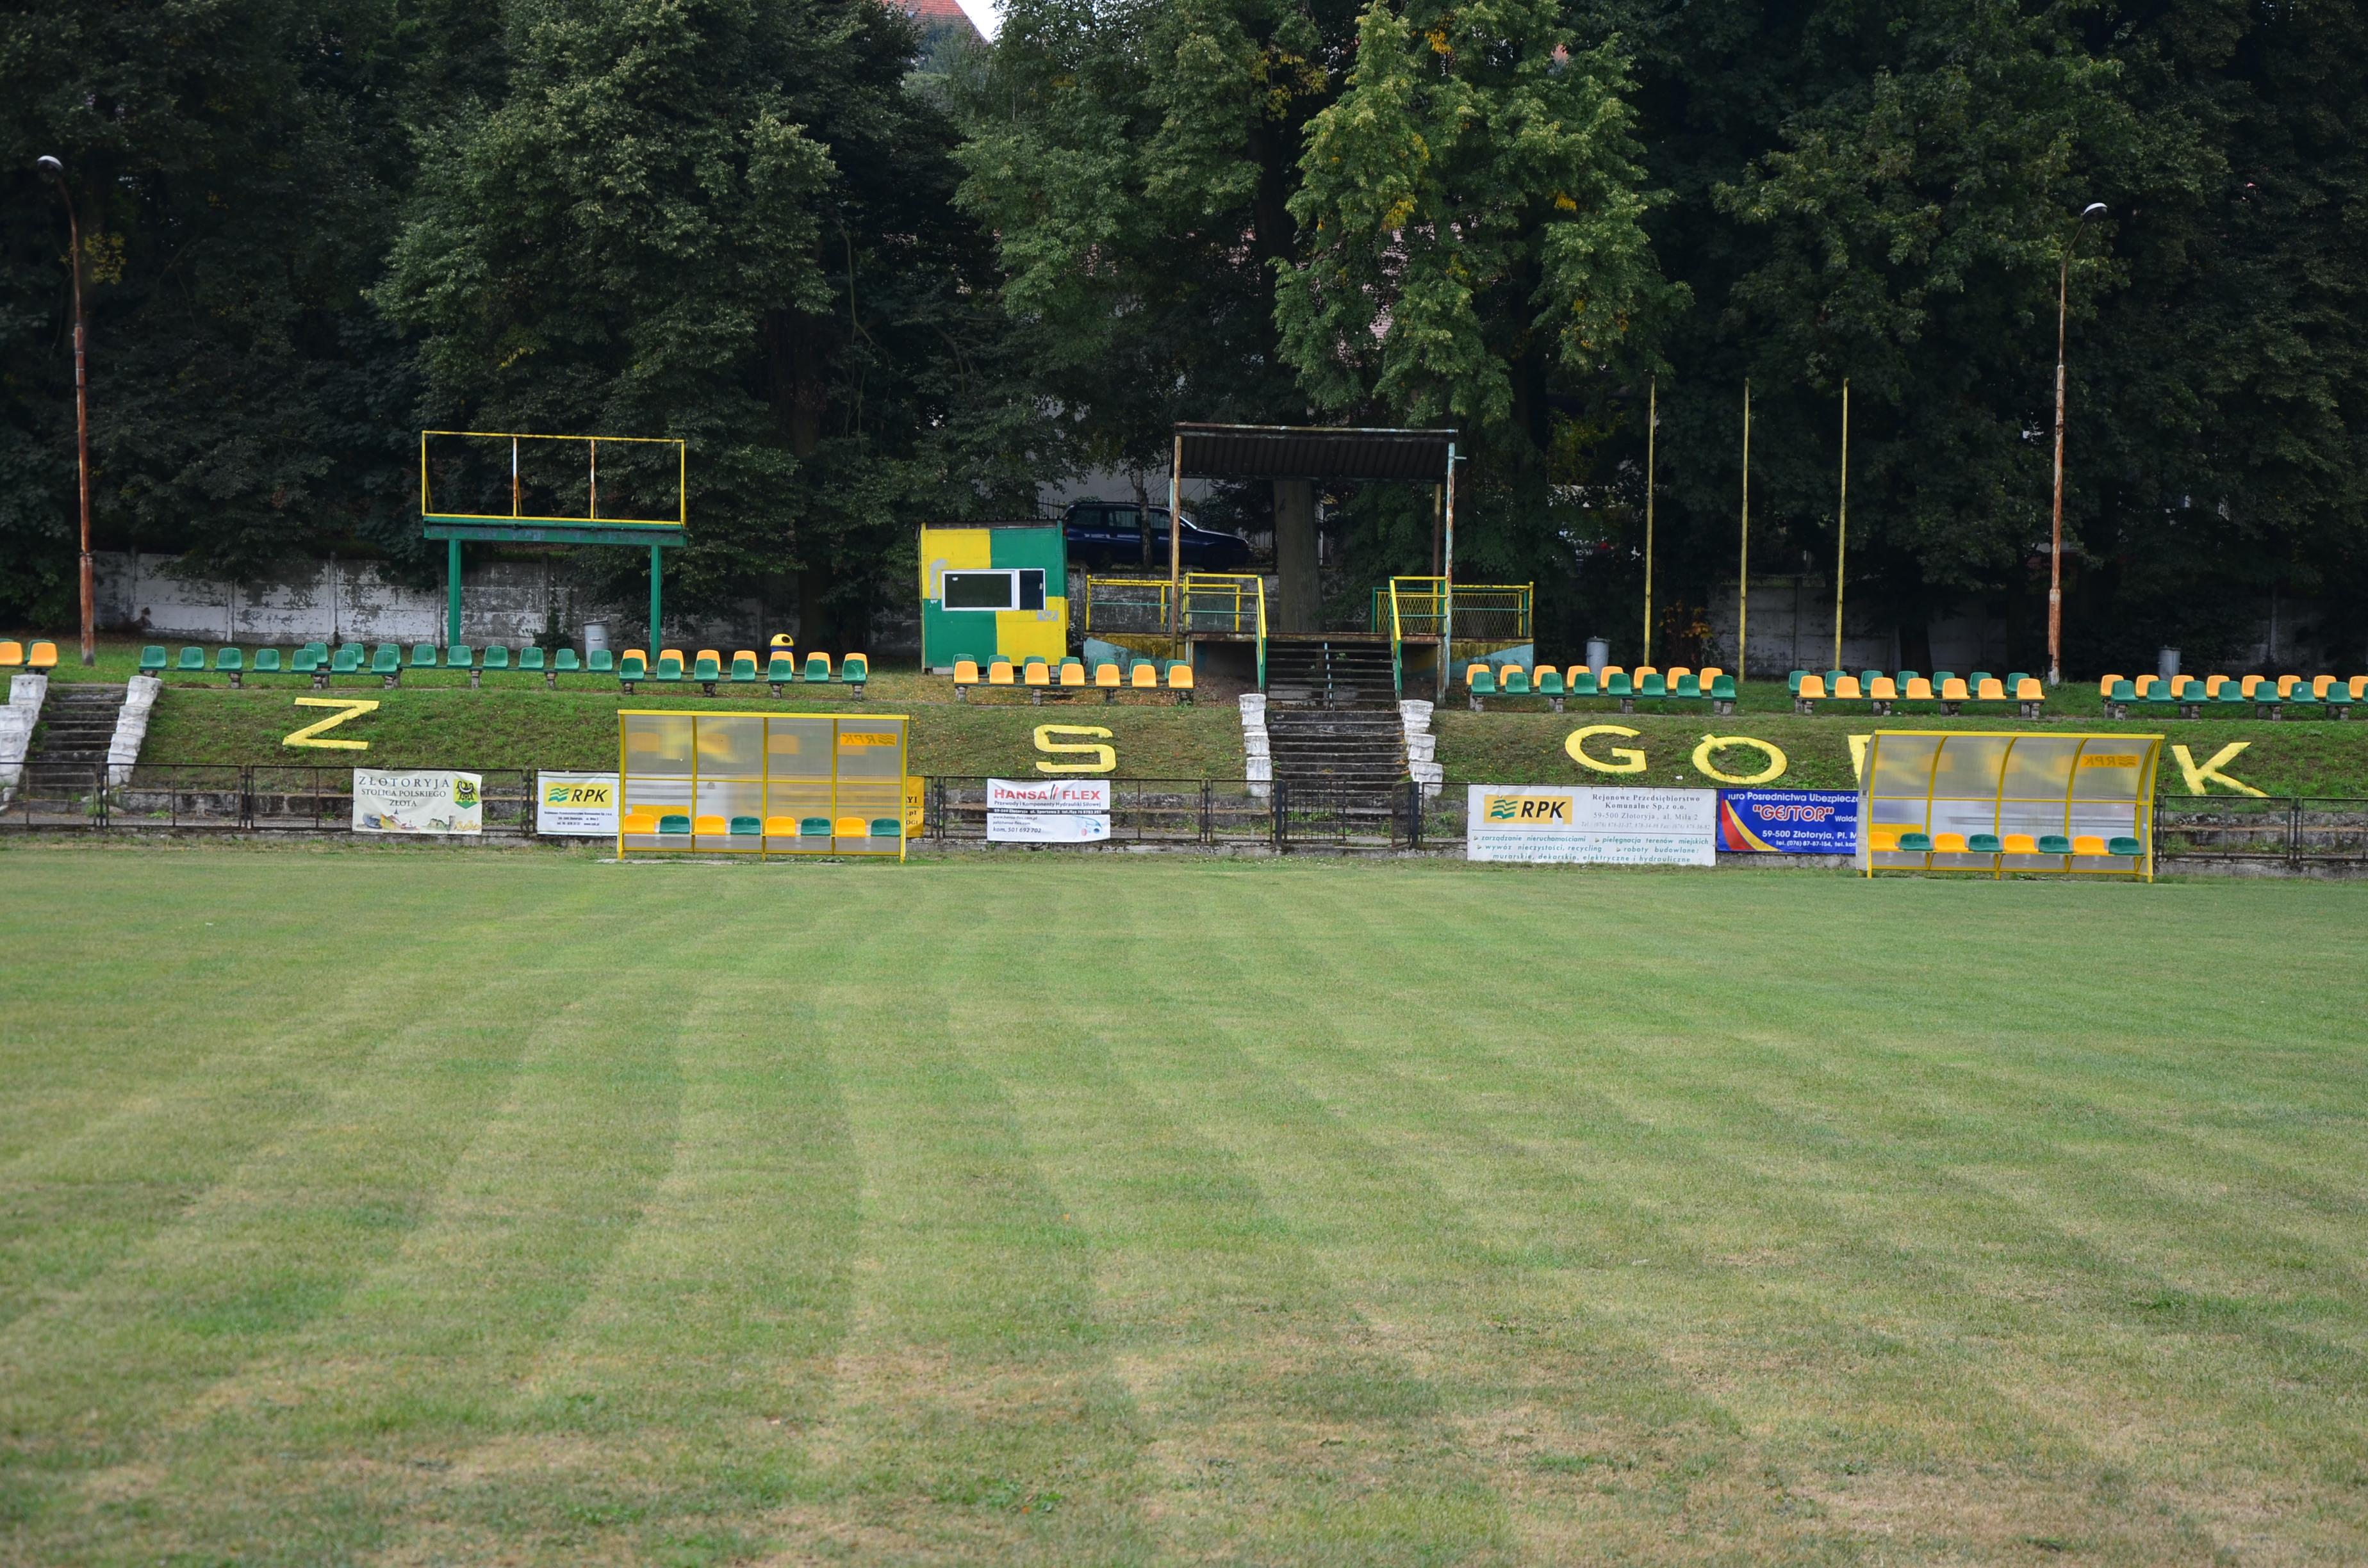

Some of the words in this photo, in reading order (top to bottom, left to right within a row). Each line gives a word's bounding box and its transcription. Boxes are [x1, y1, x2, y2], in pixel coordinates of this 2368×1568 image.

[282, 698, 380, 750] Z
[1033, 724, 1117, 772] S
[358, 776, 450, 789] ZŁOTORYJA
[571, 789, 609, 803] RPK
[994, 789, 1048, 800] HANSA
[1062, 790, 1101, 800] FLEX
[1633, 794, 1700, 803] Przedsiębiorstwo
[1520, 801, 1566, 819] RPK
[1752, 804, 1835, 822] "GESTOR"
[1602, 836, 1641, 844] pielęgnacja
[1793, 831, 1834, 840] Złotoryja,
[1518, 844, 1565, 852] nieczystości,
[1568, 845, 1602, 853] recycling
[1624, 845, 1649, 854] roboty
[1583, 854, 1630, 862] elektryczne
[1639, 854, 1691, 863] hydrauliczne
